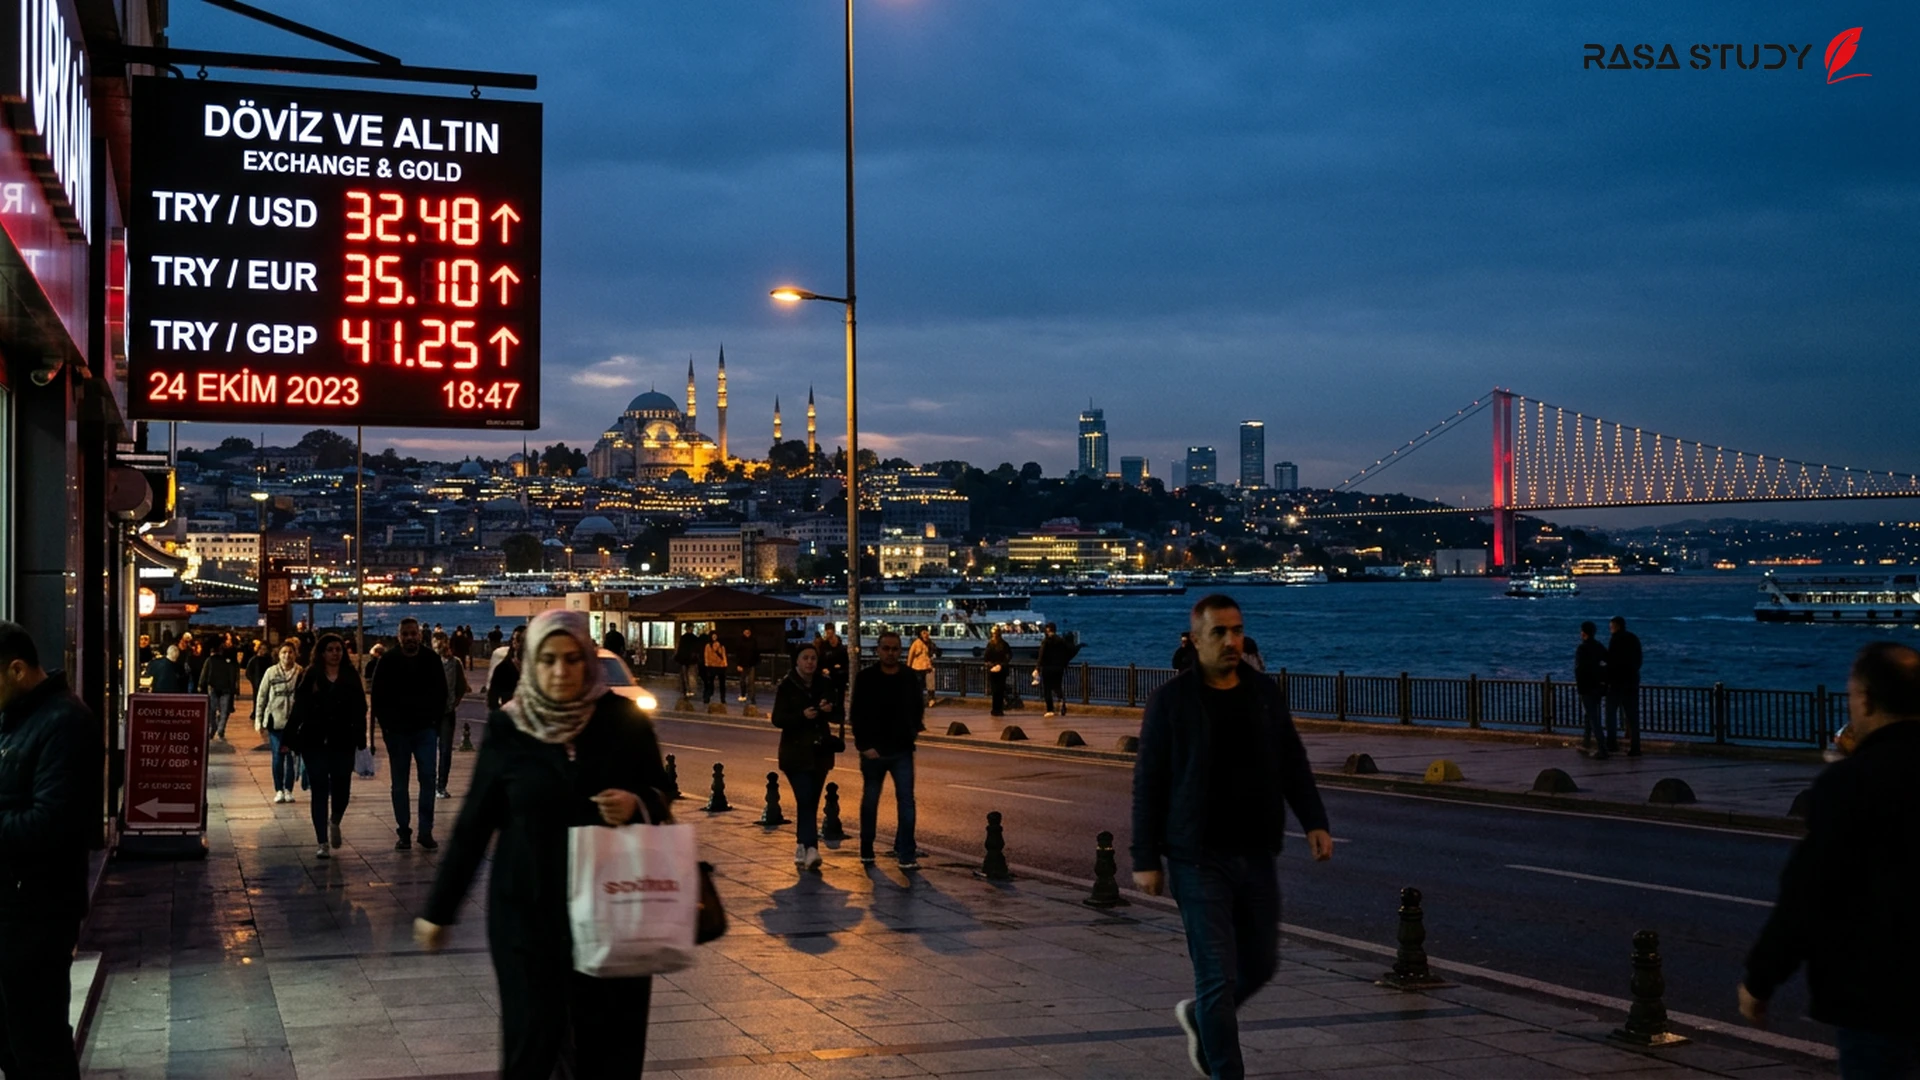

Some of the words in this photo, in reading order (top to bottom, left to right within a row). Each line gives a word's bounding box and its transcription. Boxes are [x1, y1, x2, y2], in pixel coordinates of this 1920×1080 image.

[204, 99, 324, 144] DÖVİZ
[332, 112, 384, 147] VE
[392, 117, 499, 154] ALTIN
[243, 150, 370, 177] EXCHANGE
[376, 158, 393, 178] &
[399, 159, 462, 182] GOLD
[152, 190, 220, 223] TRY
[227, 195, 240, 225] /
[248, 197, 318, 228] USD
[346, 191, 480, 245] 32.48
[151, 255, 220, 288] TRY
[226, 258, 239, 289] /
[248, 260, 318, 292] EUR
[345, 253, 480, 308] 35.10
[150, 320, 219, 350] TRY
[225, 322, 238, 353] /
[246, 323, 318, 354] GBP
[341, 318, 479, 369] 41.25
[149, 371, 187, 401] 24
[198, 368, 277, 403] EKİM
[286, 376, 359, 405] 2023
[442, 380, 520, 409] 18:47
